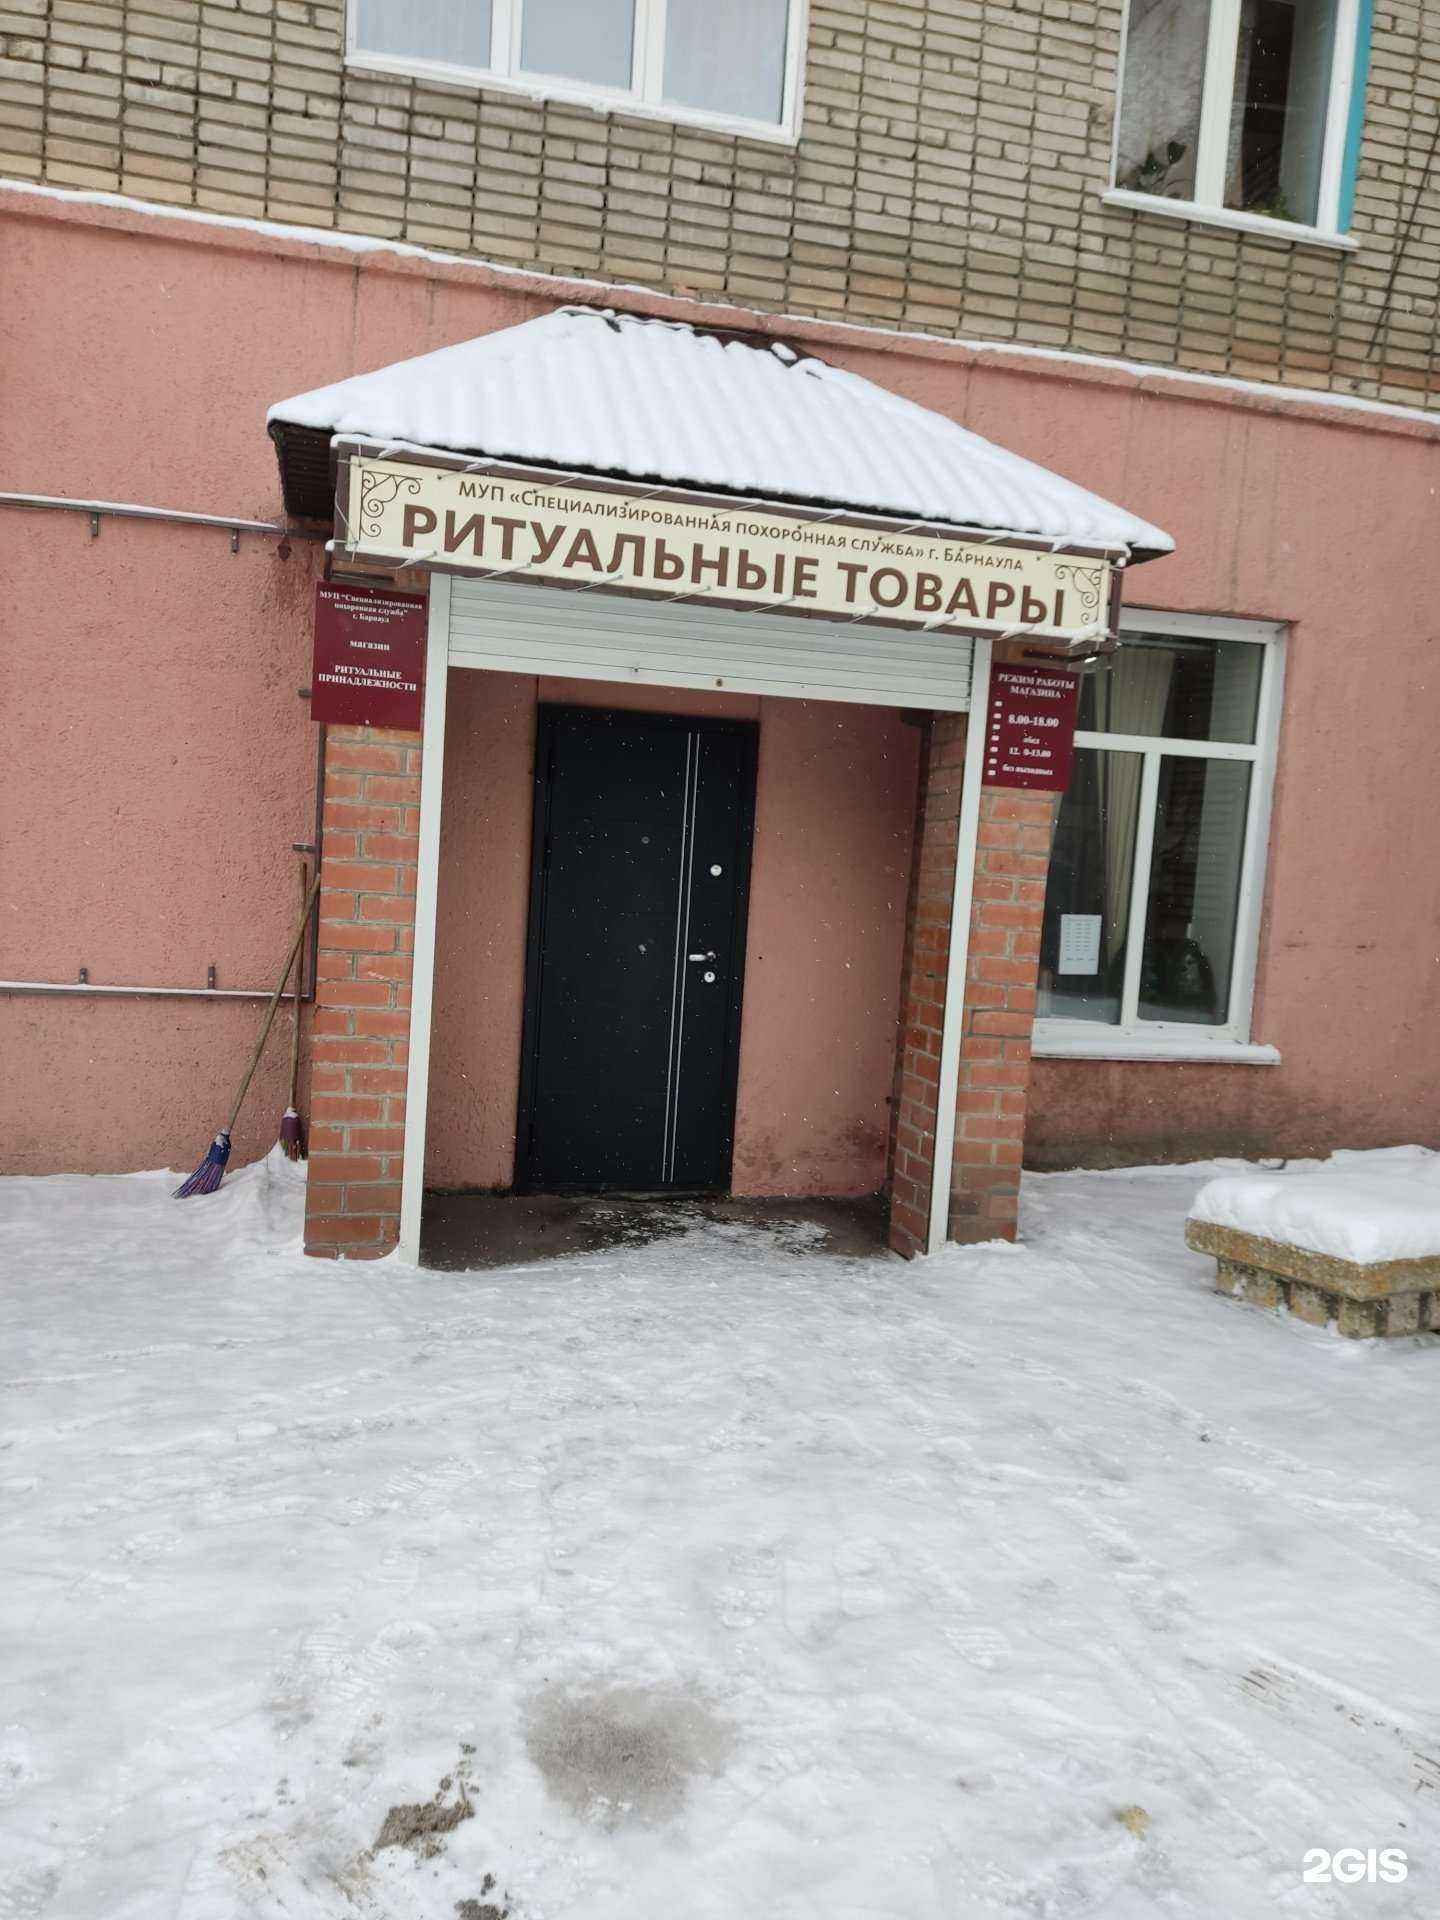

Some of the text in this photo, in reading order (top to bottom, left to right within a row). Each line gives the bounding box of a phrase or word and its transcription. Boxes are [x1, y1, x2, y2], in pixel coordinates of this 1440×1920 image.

[459, 480, 504, 502] МУП
[736, 522, 847, 549] ПОХОРОННАЯ
[851, 537, 925, 560] СЛУЖБА»
[944, 547, 1024, 572] БАРНАУЛА
[402, 503, 1066, 627] РИТУАЛЬНЫЕ ТОВАРЫ
[319, 590, 340, 600] МУП
[359, 612, 390, 623] Барнаул
[334, 664, 403, 680] РИТУАЛЬНЫЕ
[318, 673, 417, 692] ПРИНАДЛЕЖНОСТИ
[998, 673, 1075, 689] РЕЖИМ РАБОТЫ
[1009, 685, 1062, 699] МАГАЗИНА
[1008, 713, 1060, 728] 8.00-18.00
